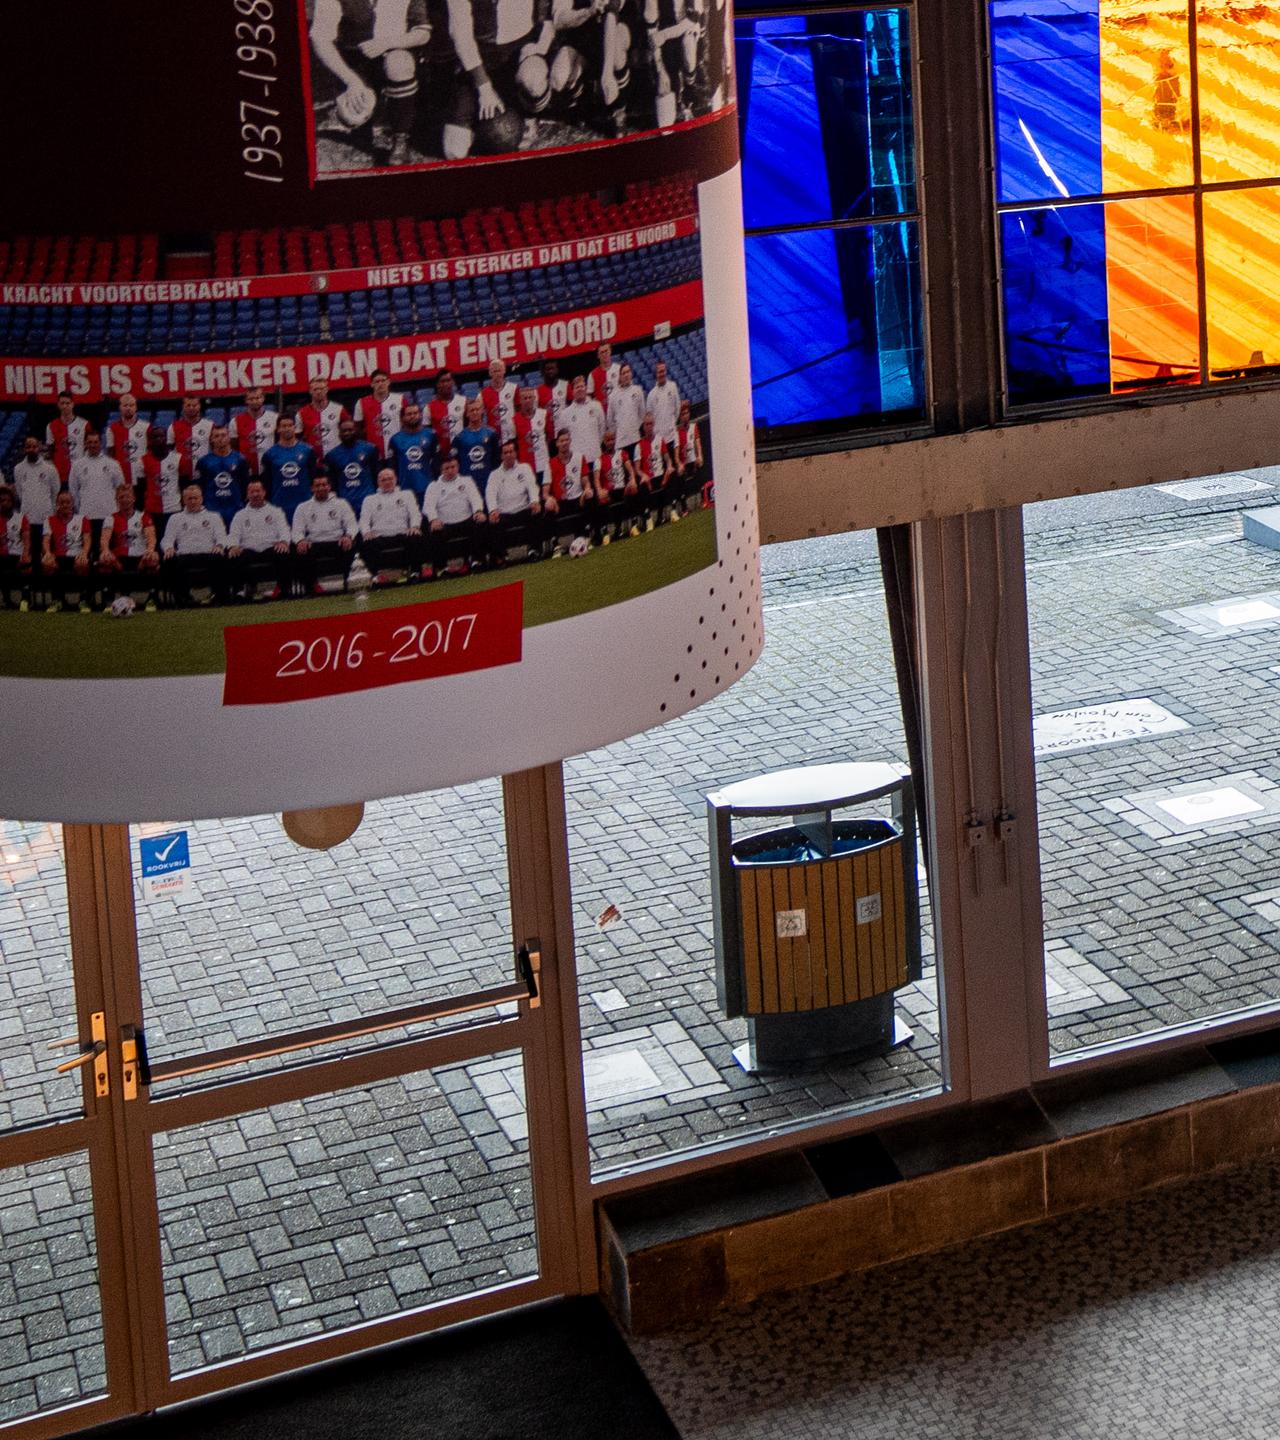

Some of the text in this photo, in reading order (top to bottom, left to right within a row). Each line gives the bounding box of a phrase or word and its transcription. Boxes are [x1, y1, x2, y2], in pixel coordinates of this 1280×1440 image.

[367, 222, 676, 286] NIETS IS STERKER DAN DAT ENE WOORD
[3, 280, 251, 303] KRACHT VOORTGEBRACHT
[4, 364, 90, 394] NIETS
[101, 363, 132, 394] IS
[142, 355, 296, 393] STERKER
[307, 347, 378, 383] DAN
[389, 338, 450, 374] DAT
[460, 330, 516, 365] ENE
[523, 312, 616, 353] WOORD
[147, 861, 186, 872] ROOKVRIJ
